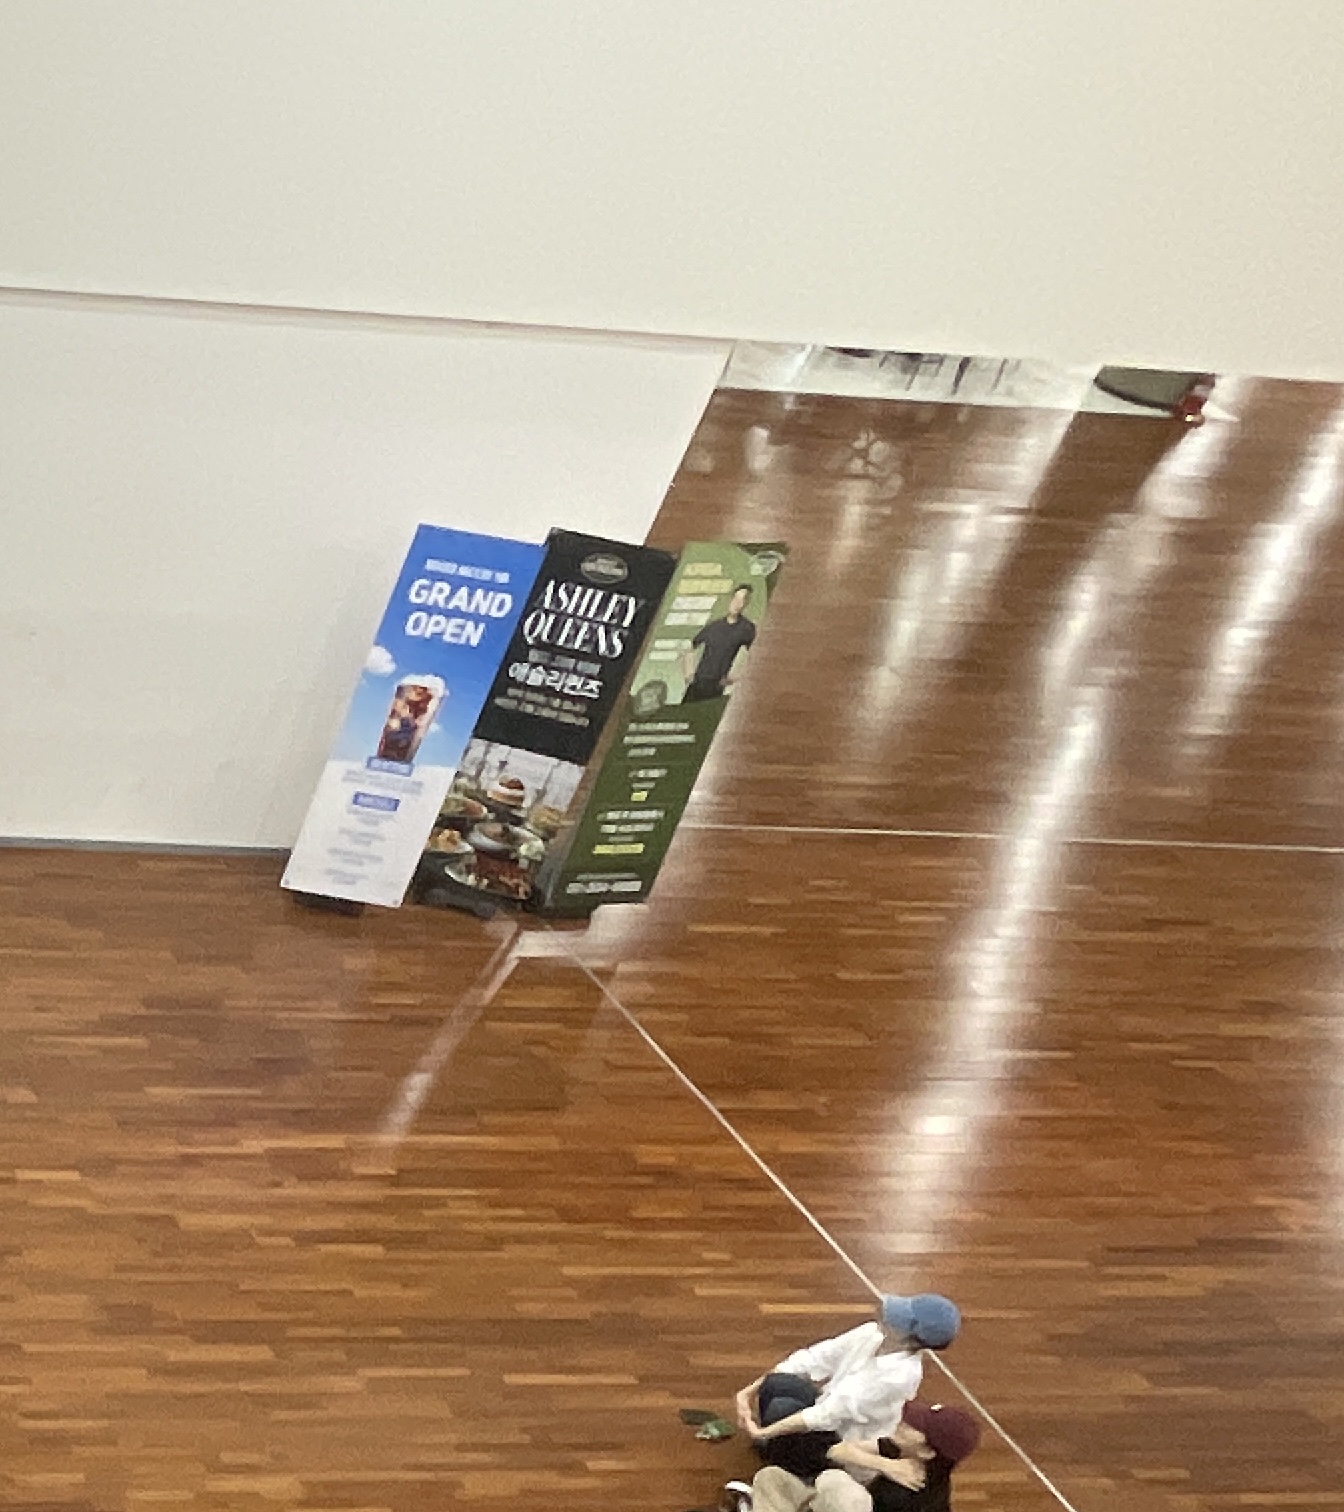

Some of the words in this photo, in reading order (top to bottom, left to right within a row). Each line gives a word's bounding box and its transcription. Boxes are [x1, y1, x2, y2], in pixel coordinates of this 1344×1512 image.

[408, 578, 512, 618] GRAND
[535, 578, 647, 628] ASHLEY
[404, 610, 486, 648] OPEN
[523, 608, 630, 659] QUEENS
